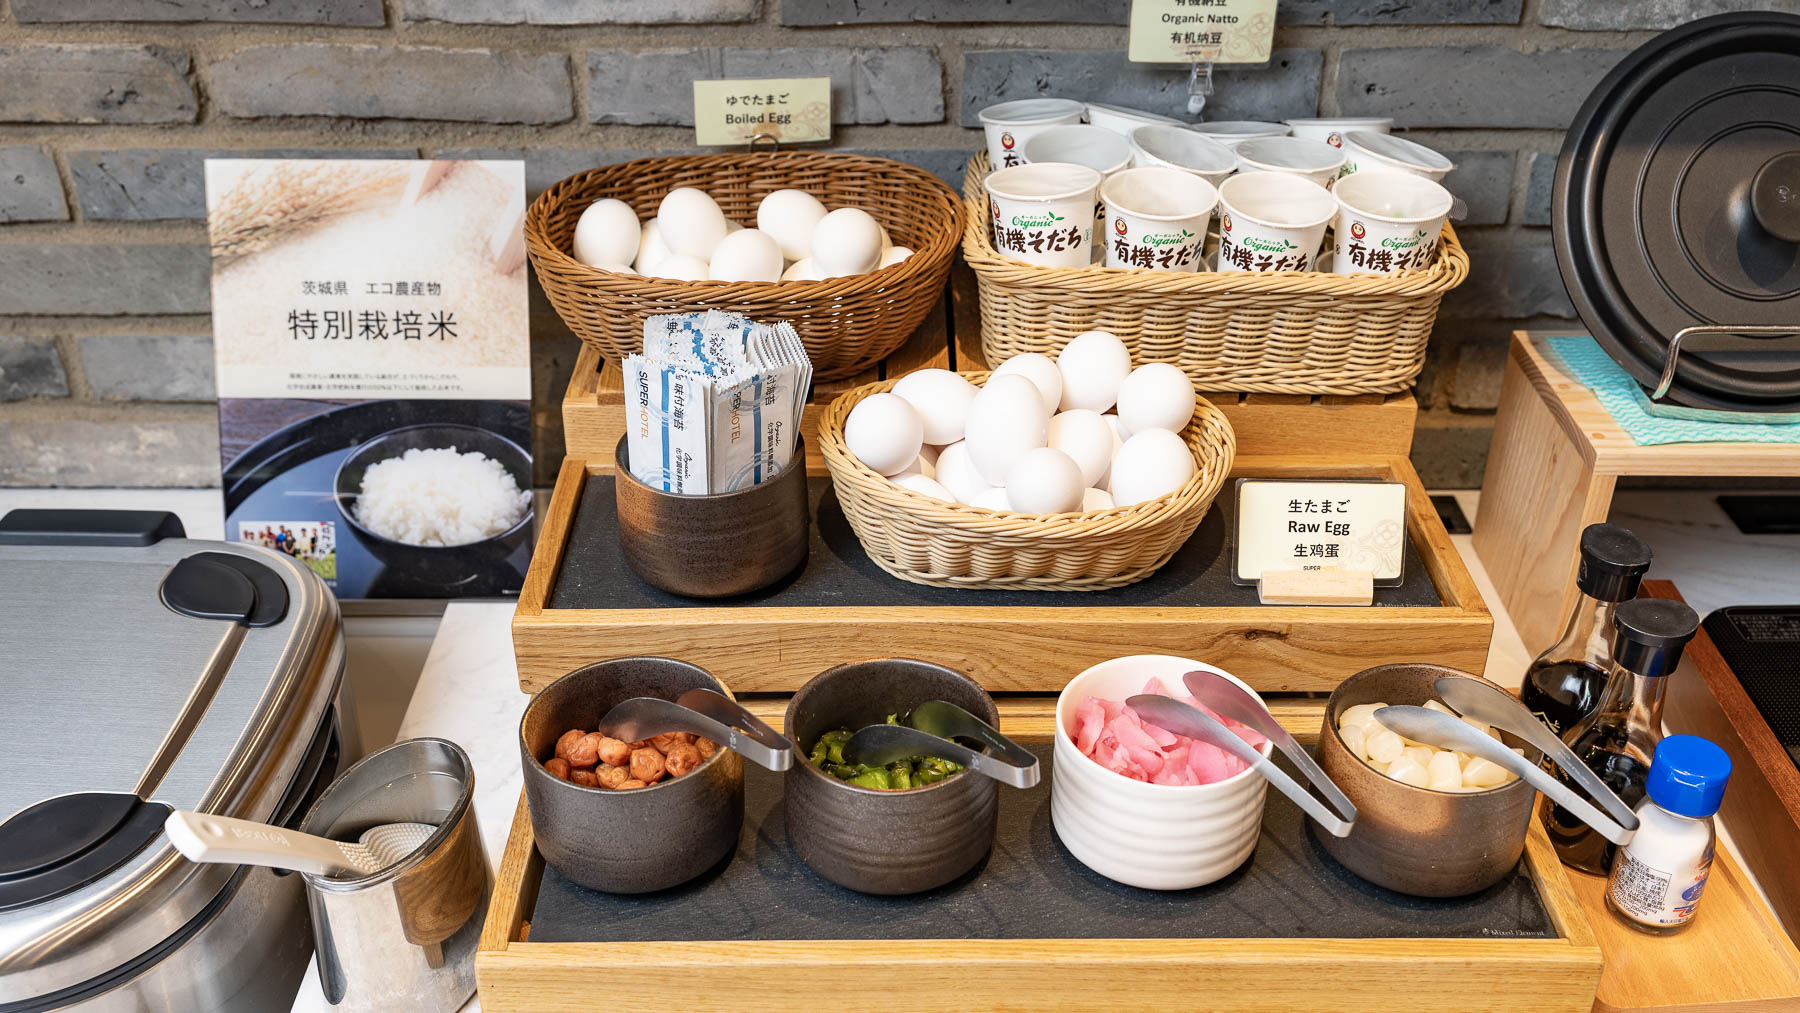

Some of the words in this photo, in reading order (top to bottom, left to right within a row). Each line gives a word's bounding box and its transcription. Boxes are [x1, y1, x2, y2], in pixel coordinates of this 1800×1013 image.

[1161, 12, 1204, 26] Organic
[1207, 14, 1239, 24] Natto
[1170, 32, 1223, 45] 有机纳豆
[726, 93, 790, 106] ゆでたまご
[726, 113, 765, 125] Boiled
[768, 112, 792, 124] Egg
[1012, 215, 1054, 230] Organic
[995, 223, 1082, 254] 有機そだち
[1142, 234, 1185, 248] Organic
[1243, 236, 1286, 253] Organic
[302, 281, 349, 296] 茨城県
[365, 281, 442, 297] エコ農産物
[287, 309, 459, 341] 特別栽培米
[638, 370, 649, 439] SUPERHOTEL
[731, 391, 742, 444] PERHOTEL
[1288, 498, 1351, 514] 生たまご
[1288, 520, 1320, 533] Raw
[1325, 520, 1351, 536] Egg
[1293, 543, 1340, 559] 生鸡蛋
